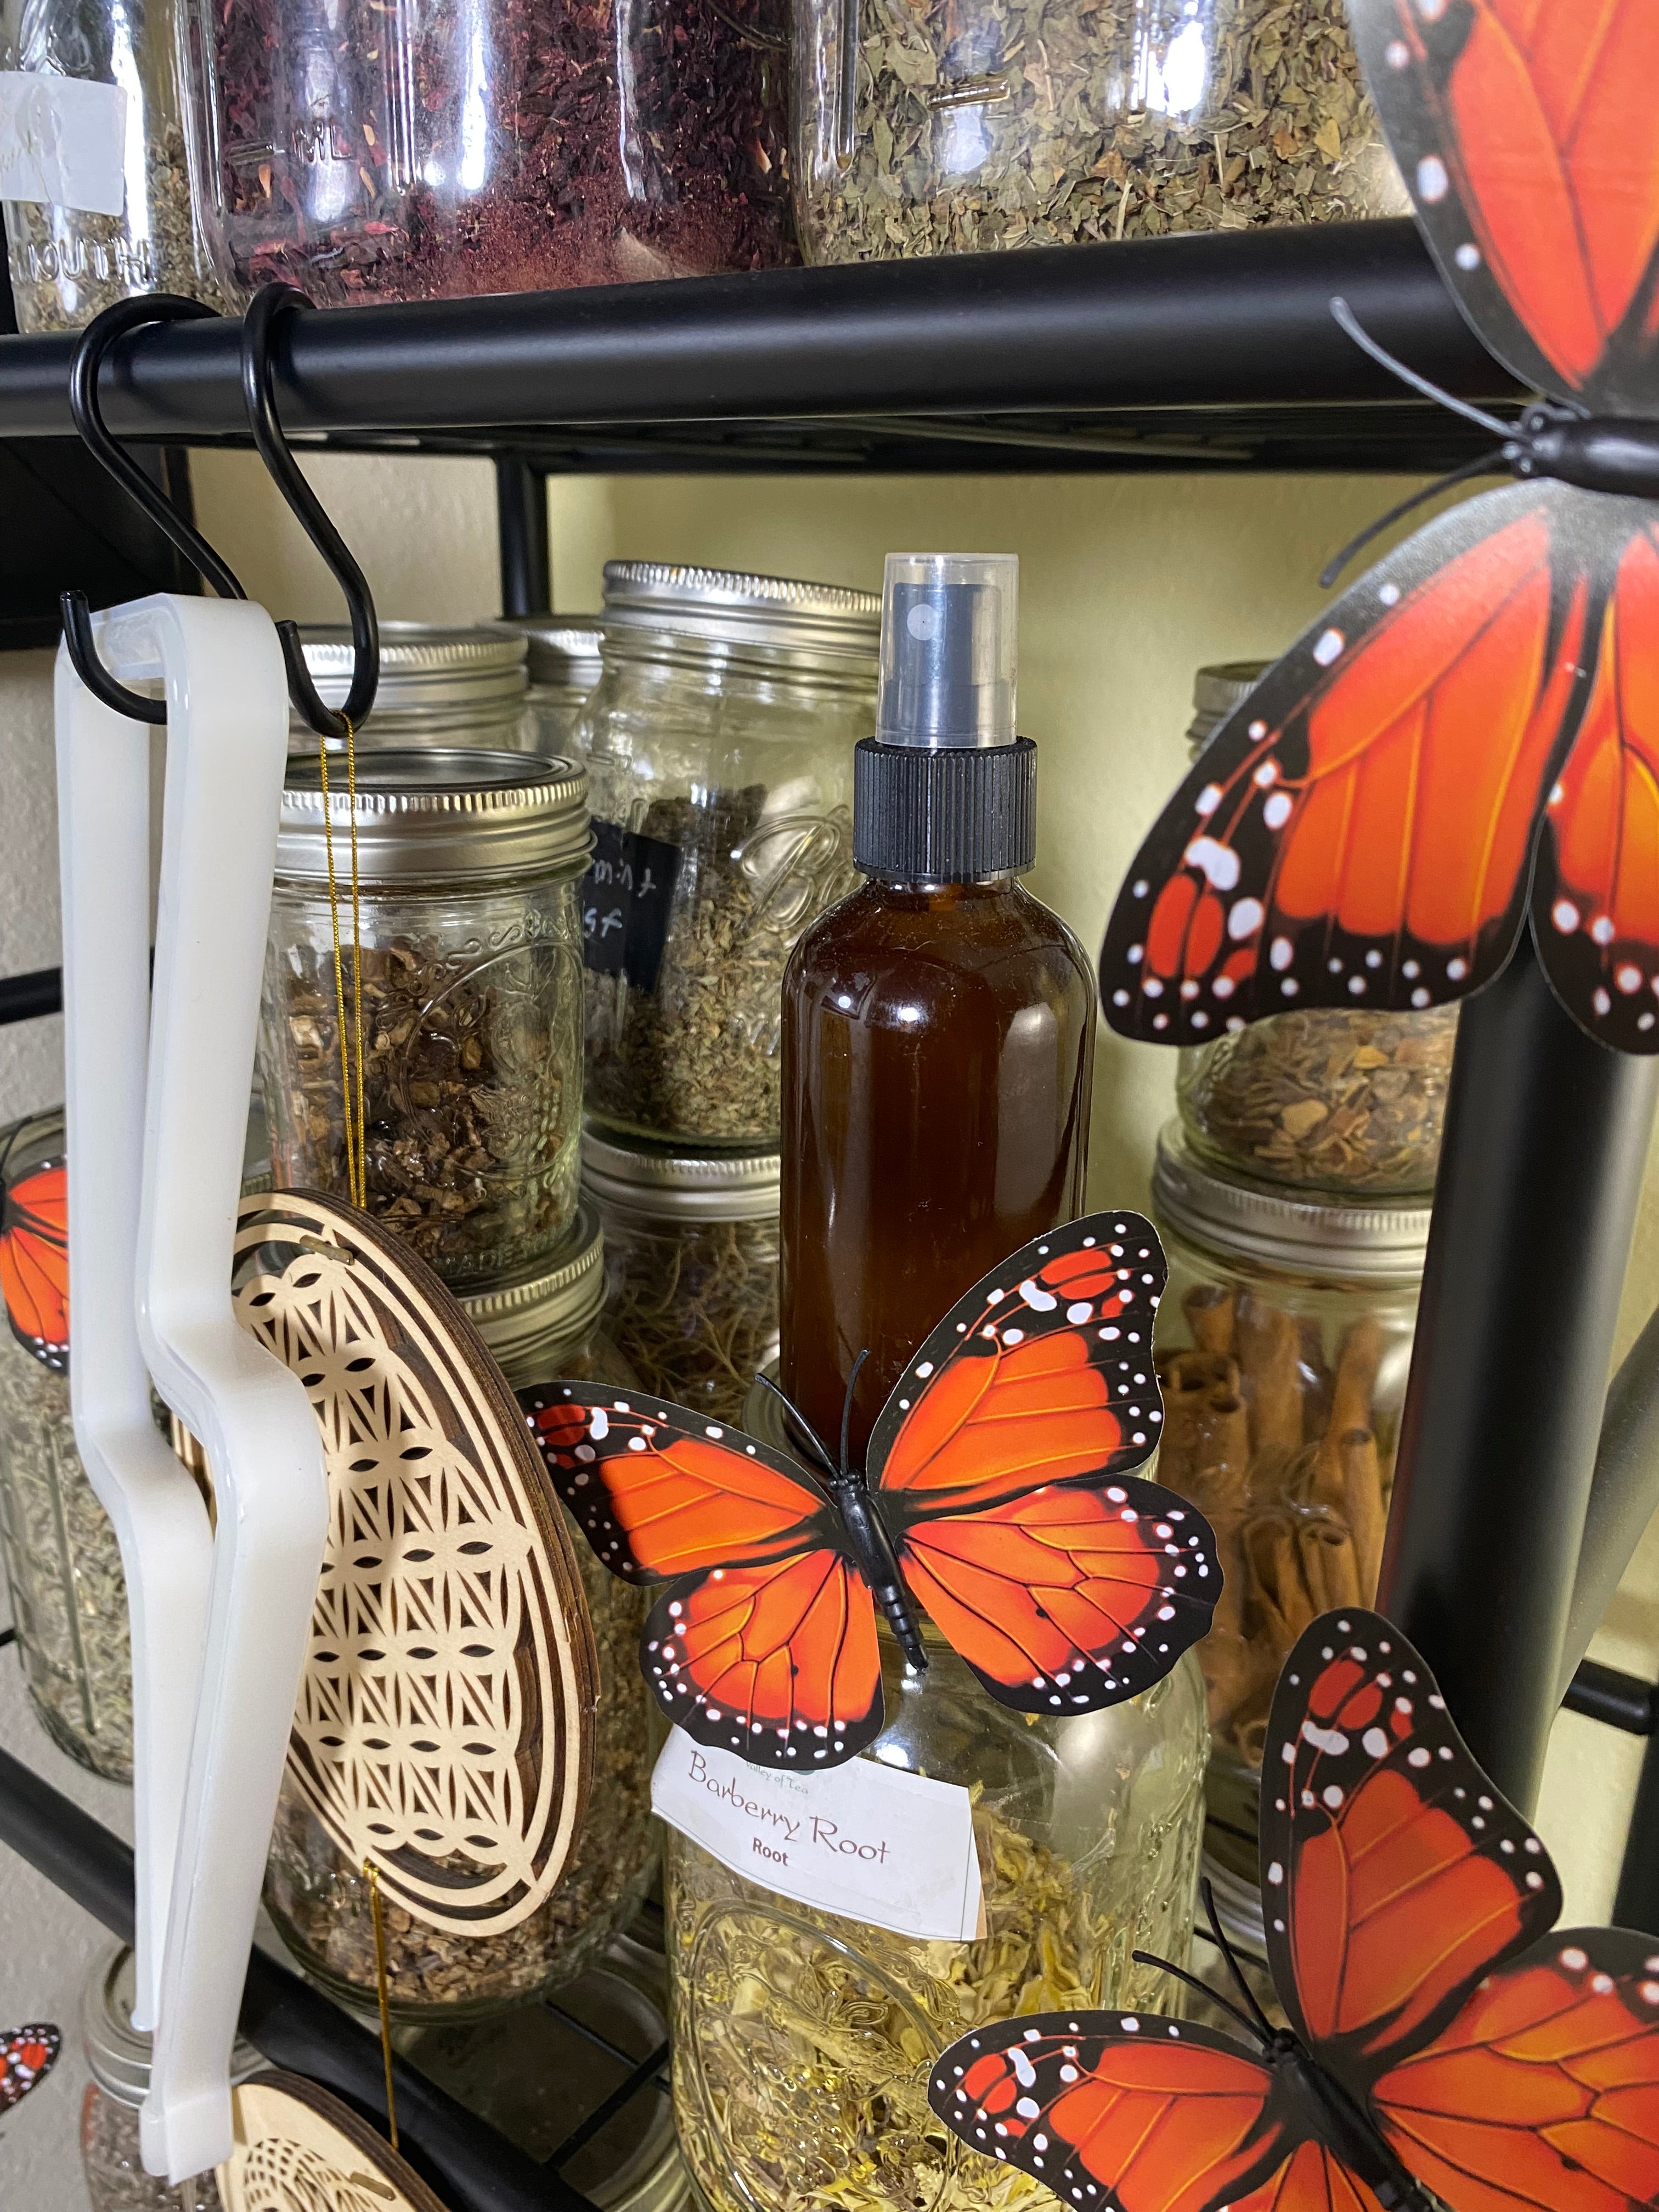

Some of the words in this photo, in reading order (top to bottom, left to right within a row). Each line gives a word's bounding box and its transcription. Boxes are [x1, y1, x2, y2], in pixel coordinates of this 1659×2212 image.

[592, 857, 657, 898] mint
[746, 1761, 772, 1781] Valley
[774, 1774, 786, 1788] of
[787, 1776, 808, 1794] Tea
[689, 1750, 800, 1842] Barberry
[809, 1815, 890, 1864] Root
[753, 1836, 788, 1866] Root
